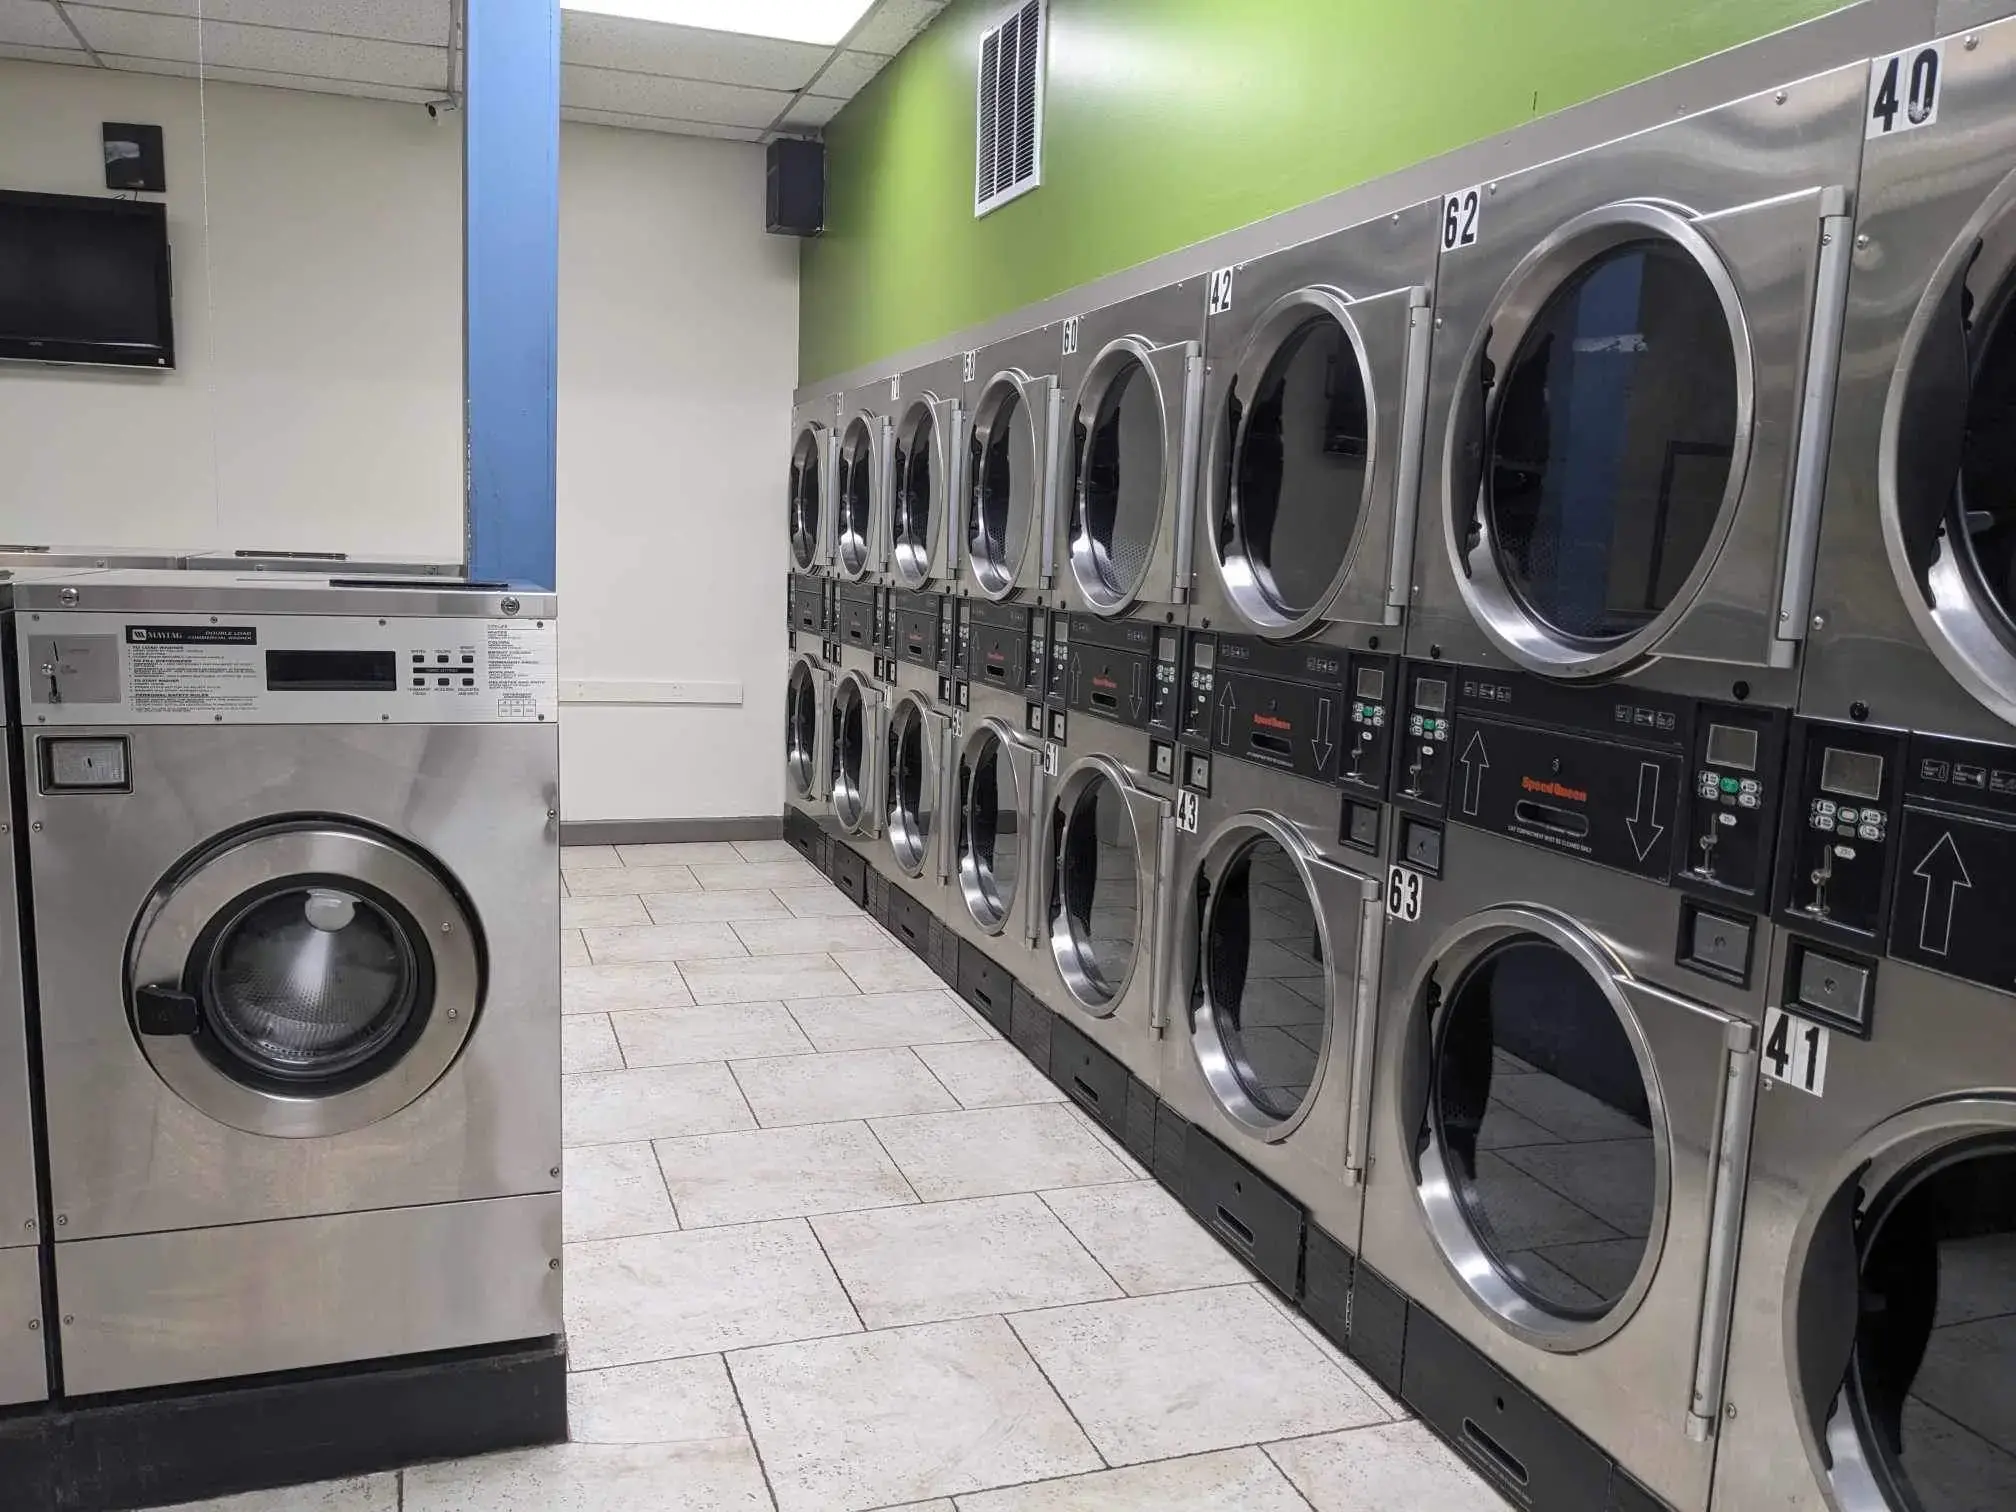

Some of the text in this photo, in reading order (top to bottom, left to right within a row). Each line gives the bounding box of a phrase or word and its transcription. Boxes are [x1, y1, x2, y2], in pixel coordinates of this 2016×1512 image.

[1873, 48, 1938, 133] 40
[1444, 191, 1478, 248] 62
[1212, 270, 1231, 312] 42
[1064, 319, 1077, 353] 60
[147, 631, 183, 640] MAYTAG
[1045, 742, 1057, 775] 61
[1521, 776, 1587, 802] Speed Queen
[1179, 791, 1195, 830] 43
[1390, 869, 1418, 919] 63
[1766, 1013, 1820, 1092] 41
